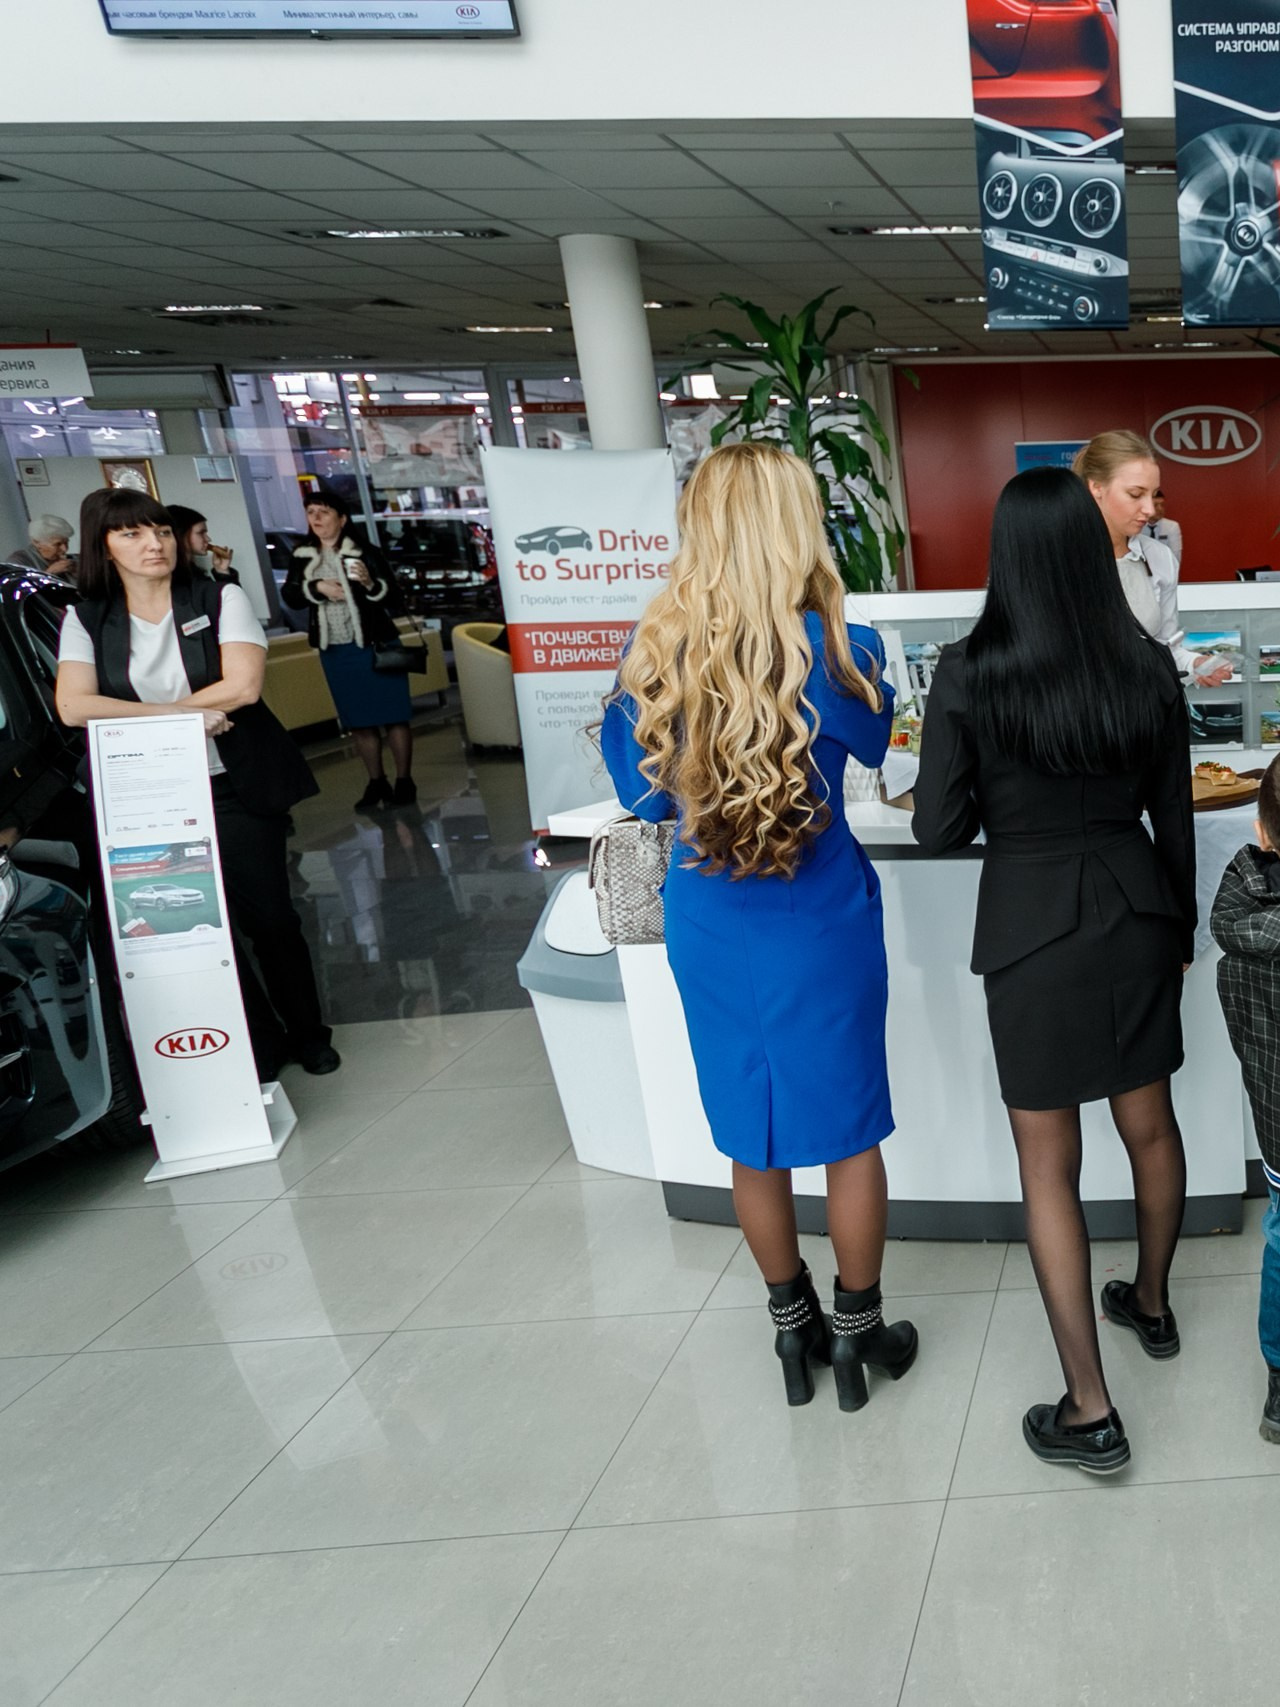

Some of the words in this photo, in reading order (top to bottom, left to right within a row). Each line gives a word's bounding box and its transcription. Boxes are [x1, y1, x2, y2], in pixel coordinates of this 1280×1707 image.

[158, 10, 193, 20] брендом
[195, 10, 227, 19] Maurice
[228, 10, 256, 19] Lacroix
[1177, 23, 1234, 36] СИСТЕМА
[1215, 40, 1280, 53] РАЗГОНОМ
[0, 360, 36, 372] ания
[1170, 419, 1244, 450] KIA
[598, 529, 669, 552] Drive
[515, 560, 547, 581] to
[555, 558, 671, 585] Surprise
[520, 594, 568, 607] Пройди
[570, 593, 638, 606] тест-драйв
[533, 650, 546, 665] В
[535, 690, 590, 702] Проведи
[537, 707, 544, 716] с
[547, 704, 599, 716] пользой
[539, 720, 582, 729] что-то
[167, 1033, 218, 1054] KIA
